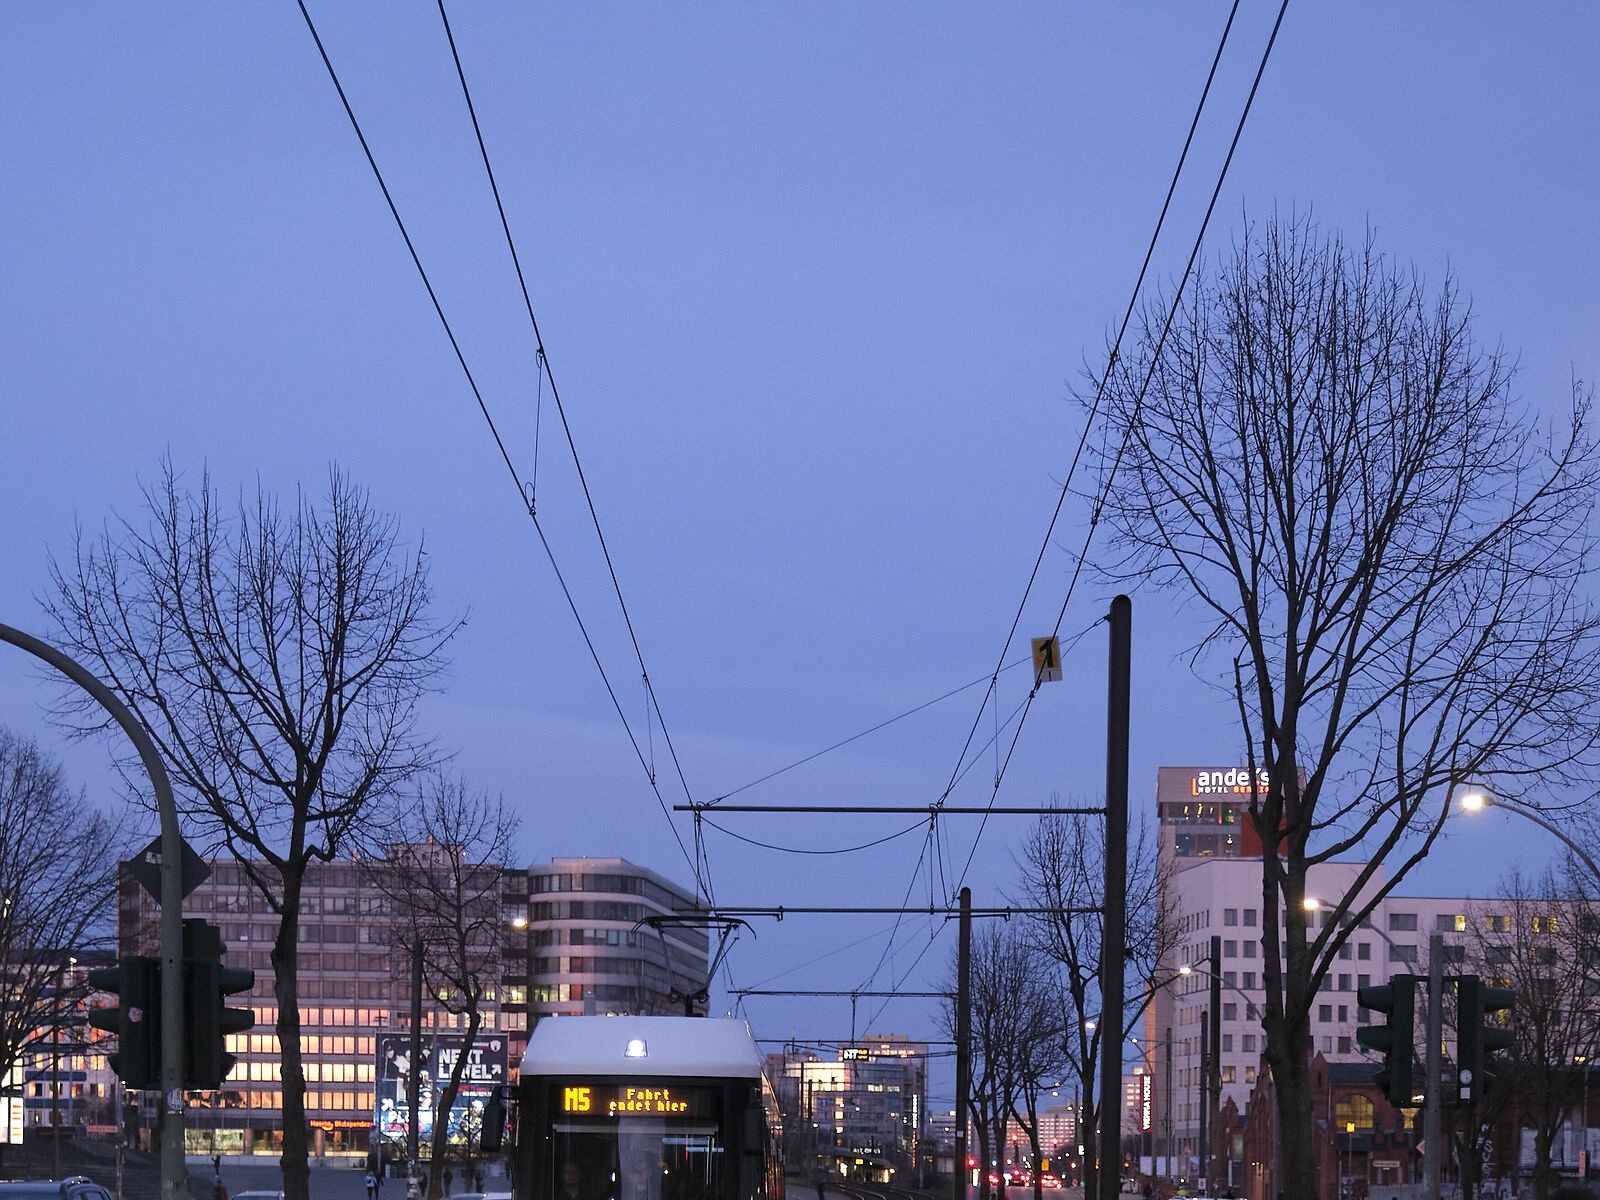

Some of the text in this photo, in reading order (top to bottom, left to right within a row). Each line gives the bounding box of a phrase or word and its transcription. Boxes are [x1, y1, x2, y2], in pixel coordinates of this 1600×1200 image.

[1198, 768, 1269, 786] ande's
[564, 1087, 591, 1111] M5
[627, 1089, 669, 1100] Fahrt
[609, 1100, 688, 1112] endet hier
